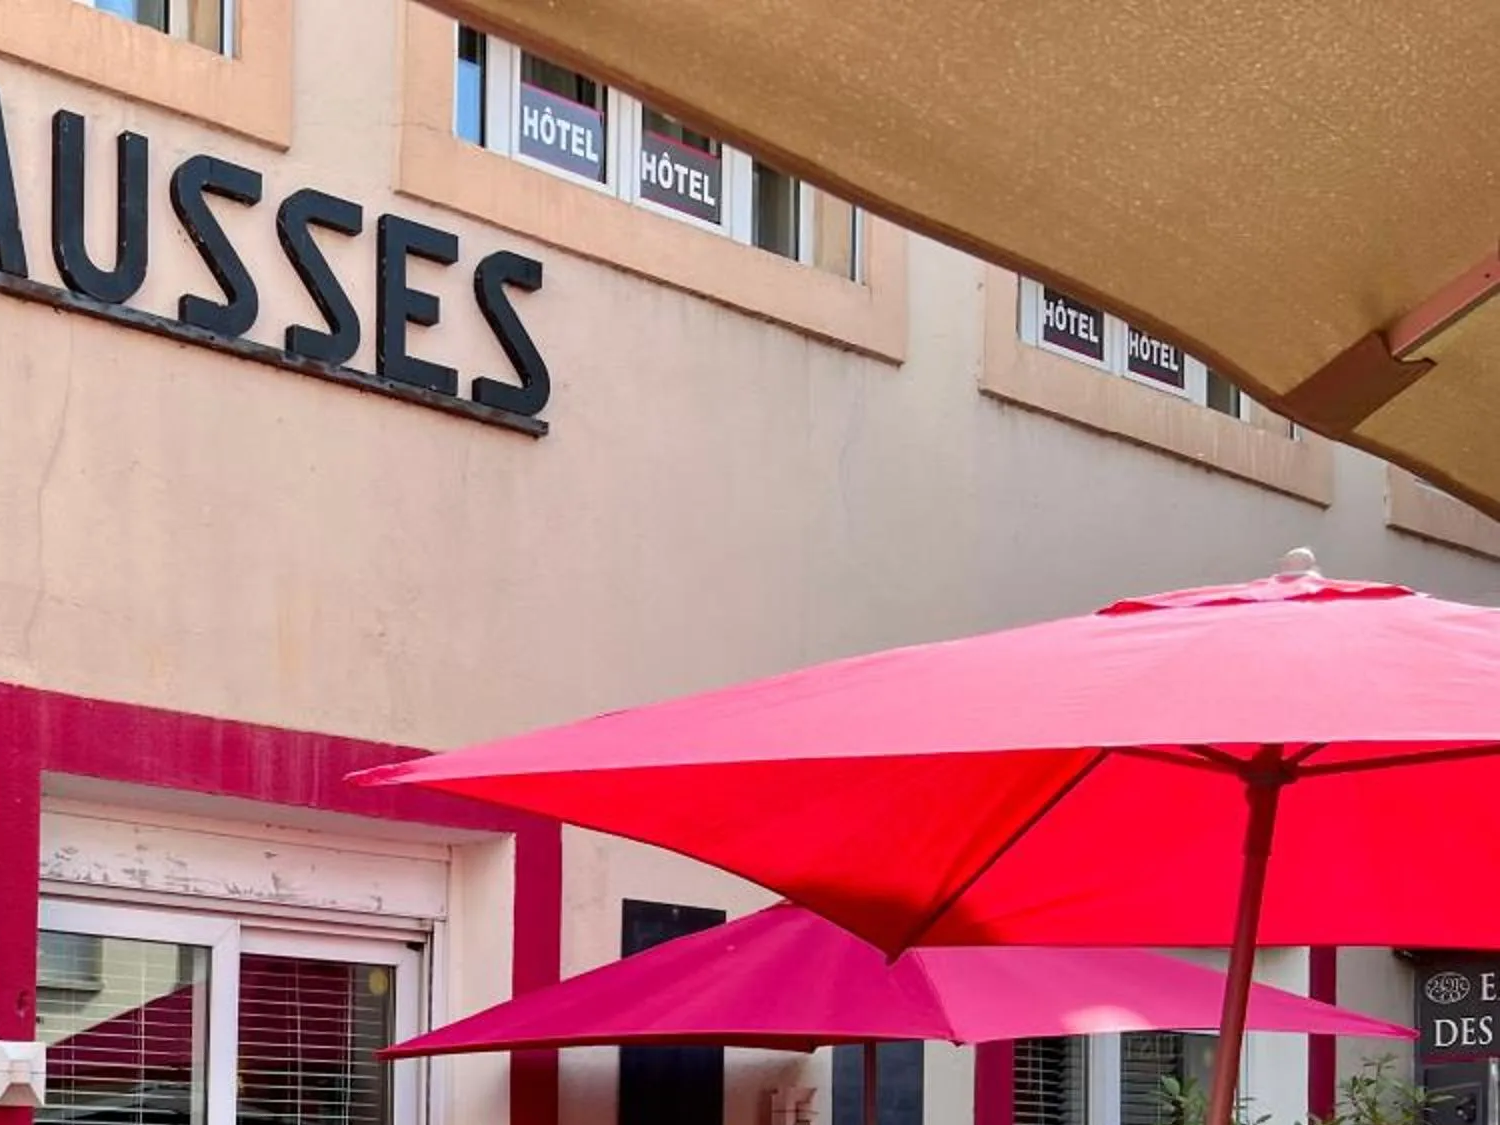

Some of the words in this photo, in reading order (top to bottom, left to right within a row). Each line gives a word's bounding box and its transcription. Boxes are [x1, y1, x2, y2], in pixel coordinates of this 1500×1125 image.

[523, 105, 598, 163] HÔTEL
[642, 151, 716, 206] HÔTEL
[1043, 298, 1100, 343] HÔTEL
[1434, 1016, 1493, 1047] DES
